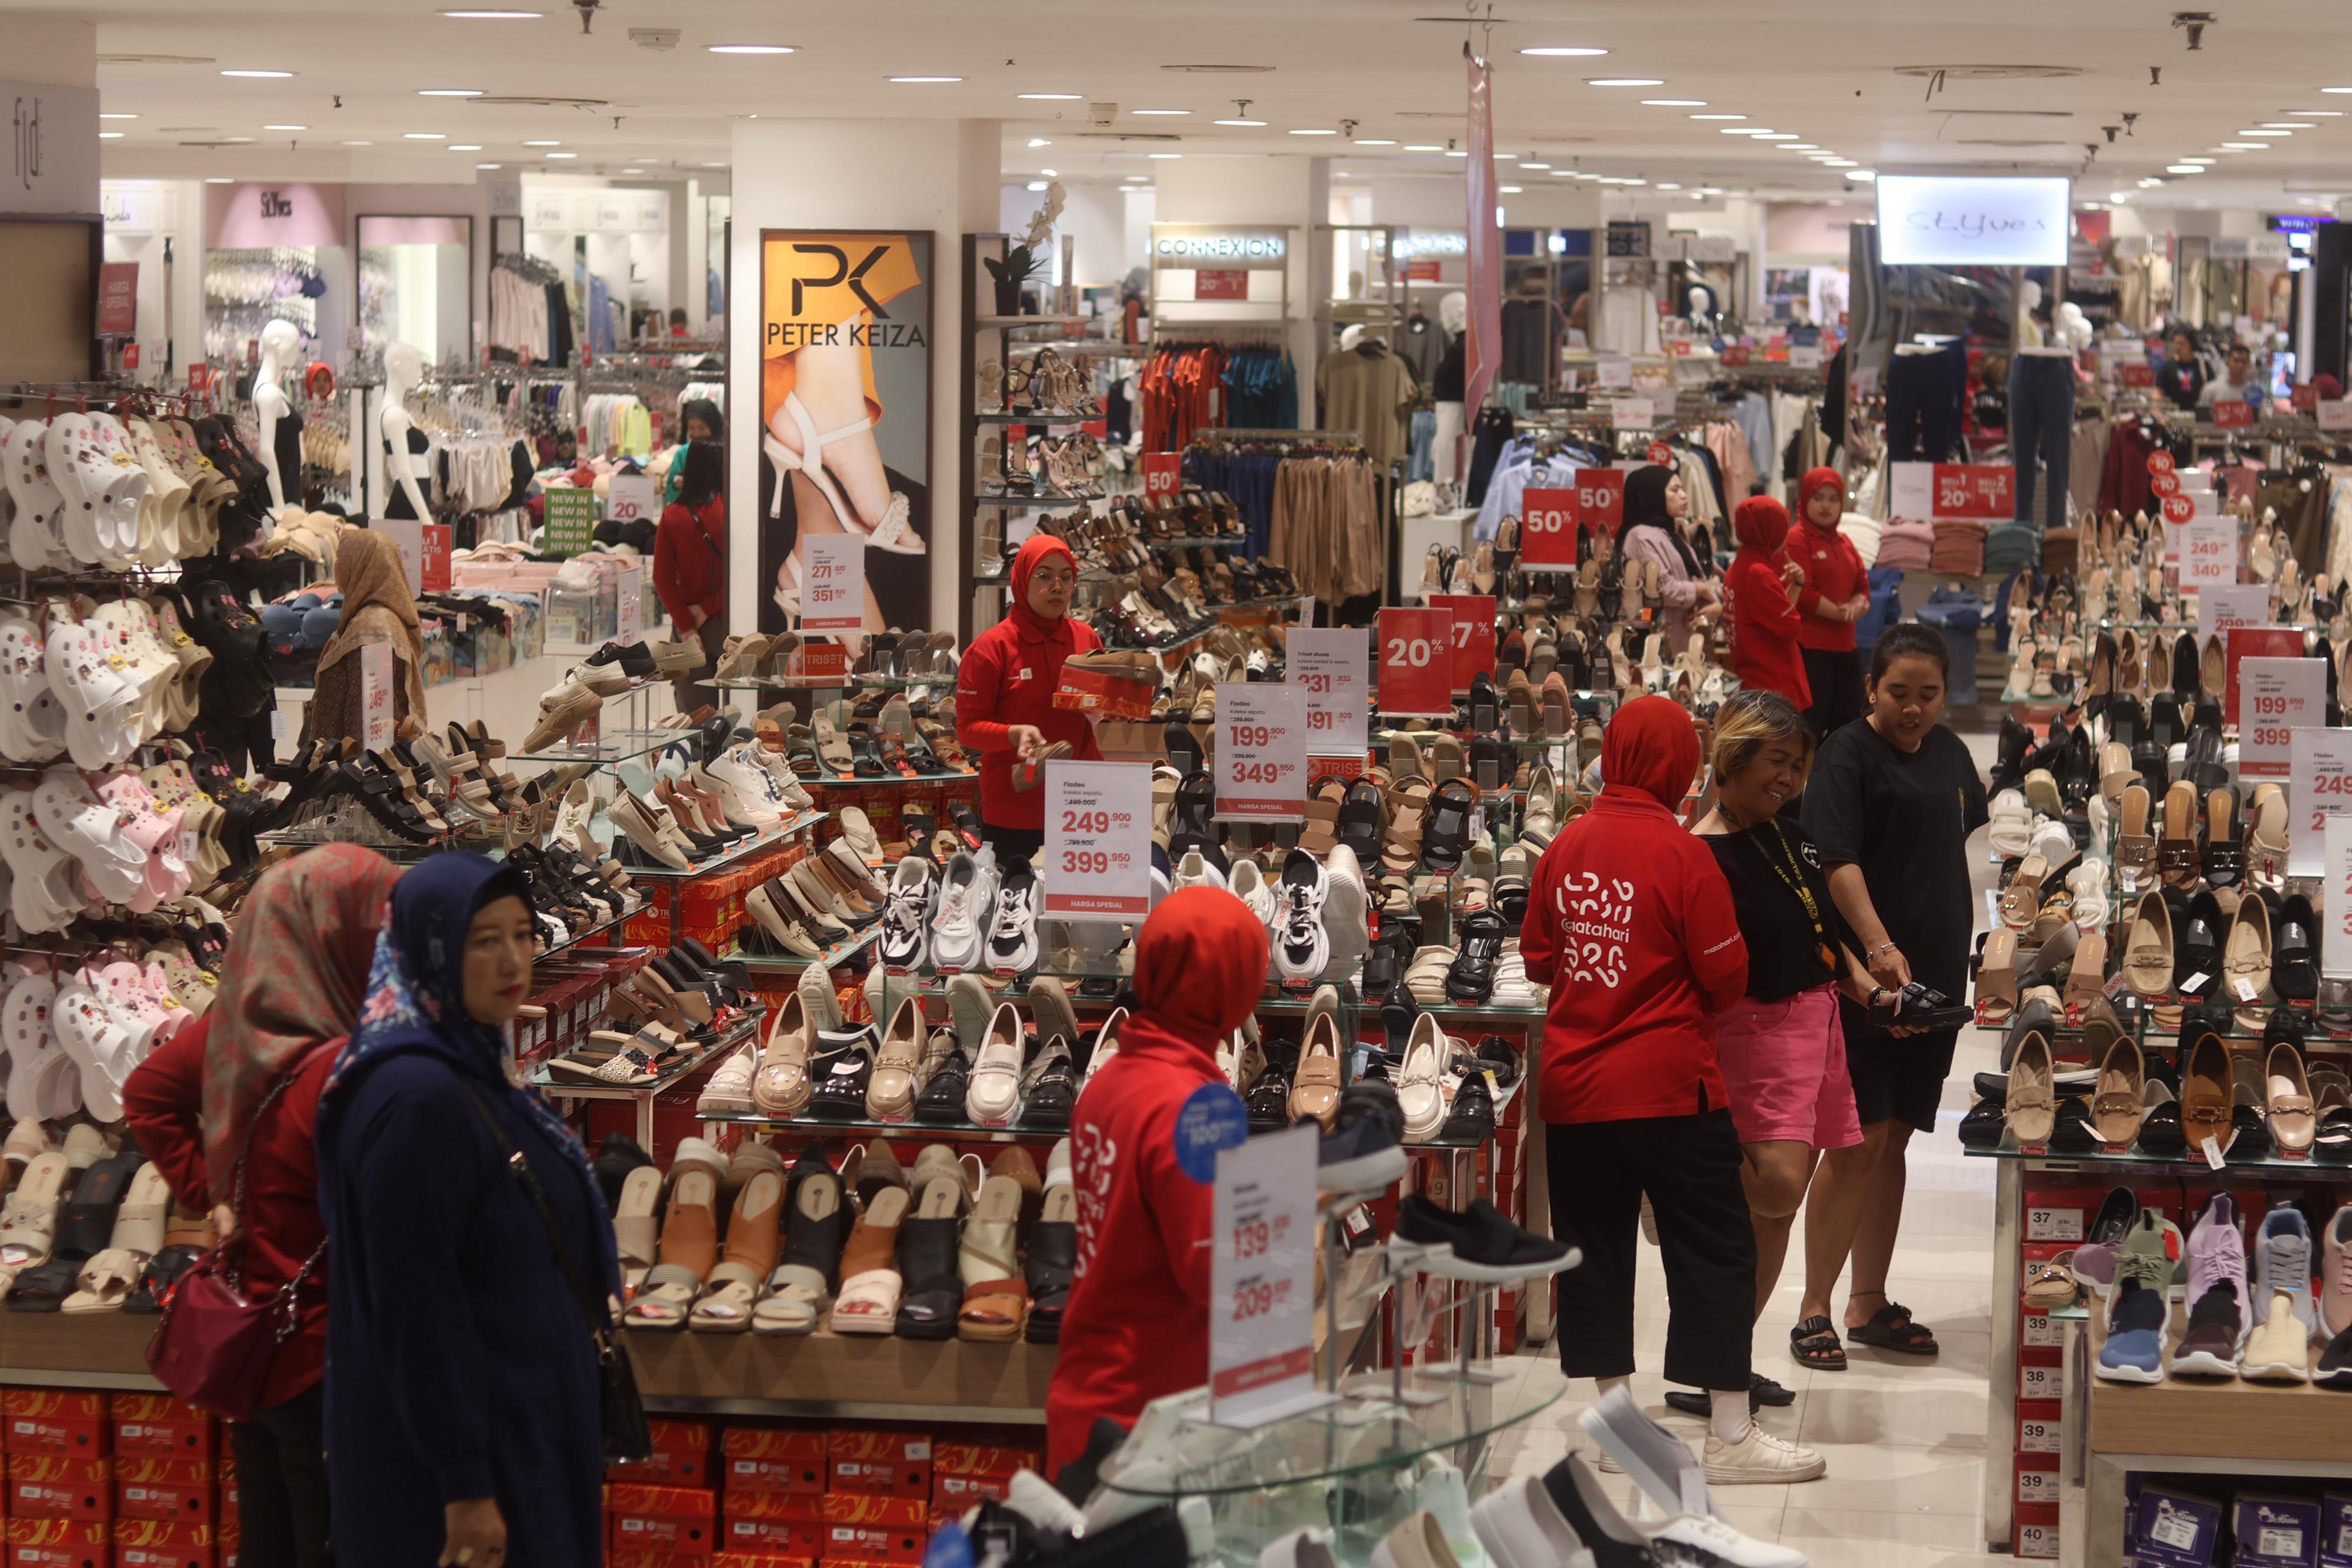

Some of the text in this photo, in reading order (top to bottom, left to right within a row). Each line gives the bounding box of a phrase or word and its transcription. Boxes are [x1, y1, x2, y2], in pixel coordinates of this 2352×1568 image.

[1158, 239, 1278, 256] CONNEXION
[792, 244, 891, 319] PK
[767, 322, 926, 348] PETER KEIZA
[551, 495, 587, 504] NEW IN
[1580, 487, 1619, 508] 50%
[551, 507, 587, 516] NEW IN
[551, 519, 587, 528] NEW IN
[1527, 509, 1572, 533] 50%
[551, 530, 587, 540] NEW IN
[550, 542, 586, 551] NEW IN
[1387, 638, 1443, 667] 20%
[806, 654, 844, 665] TRISET
[1285, 978, 1308, 986] Fladeo
[2023, 1146, 2045, 1155] Fladeo
[2033, 1212, 2051, 1223] 37
[2028, 1318, 2047, 1329] 39
[2026, 1371, 2044, 1382] 38
[2024, 1425, 2044, 1437] 39
[2022, 1475, 2042, 1487] 39
[2024, 1528, 2042, 1540] 40
